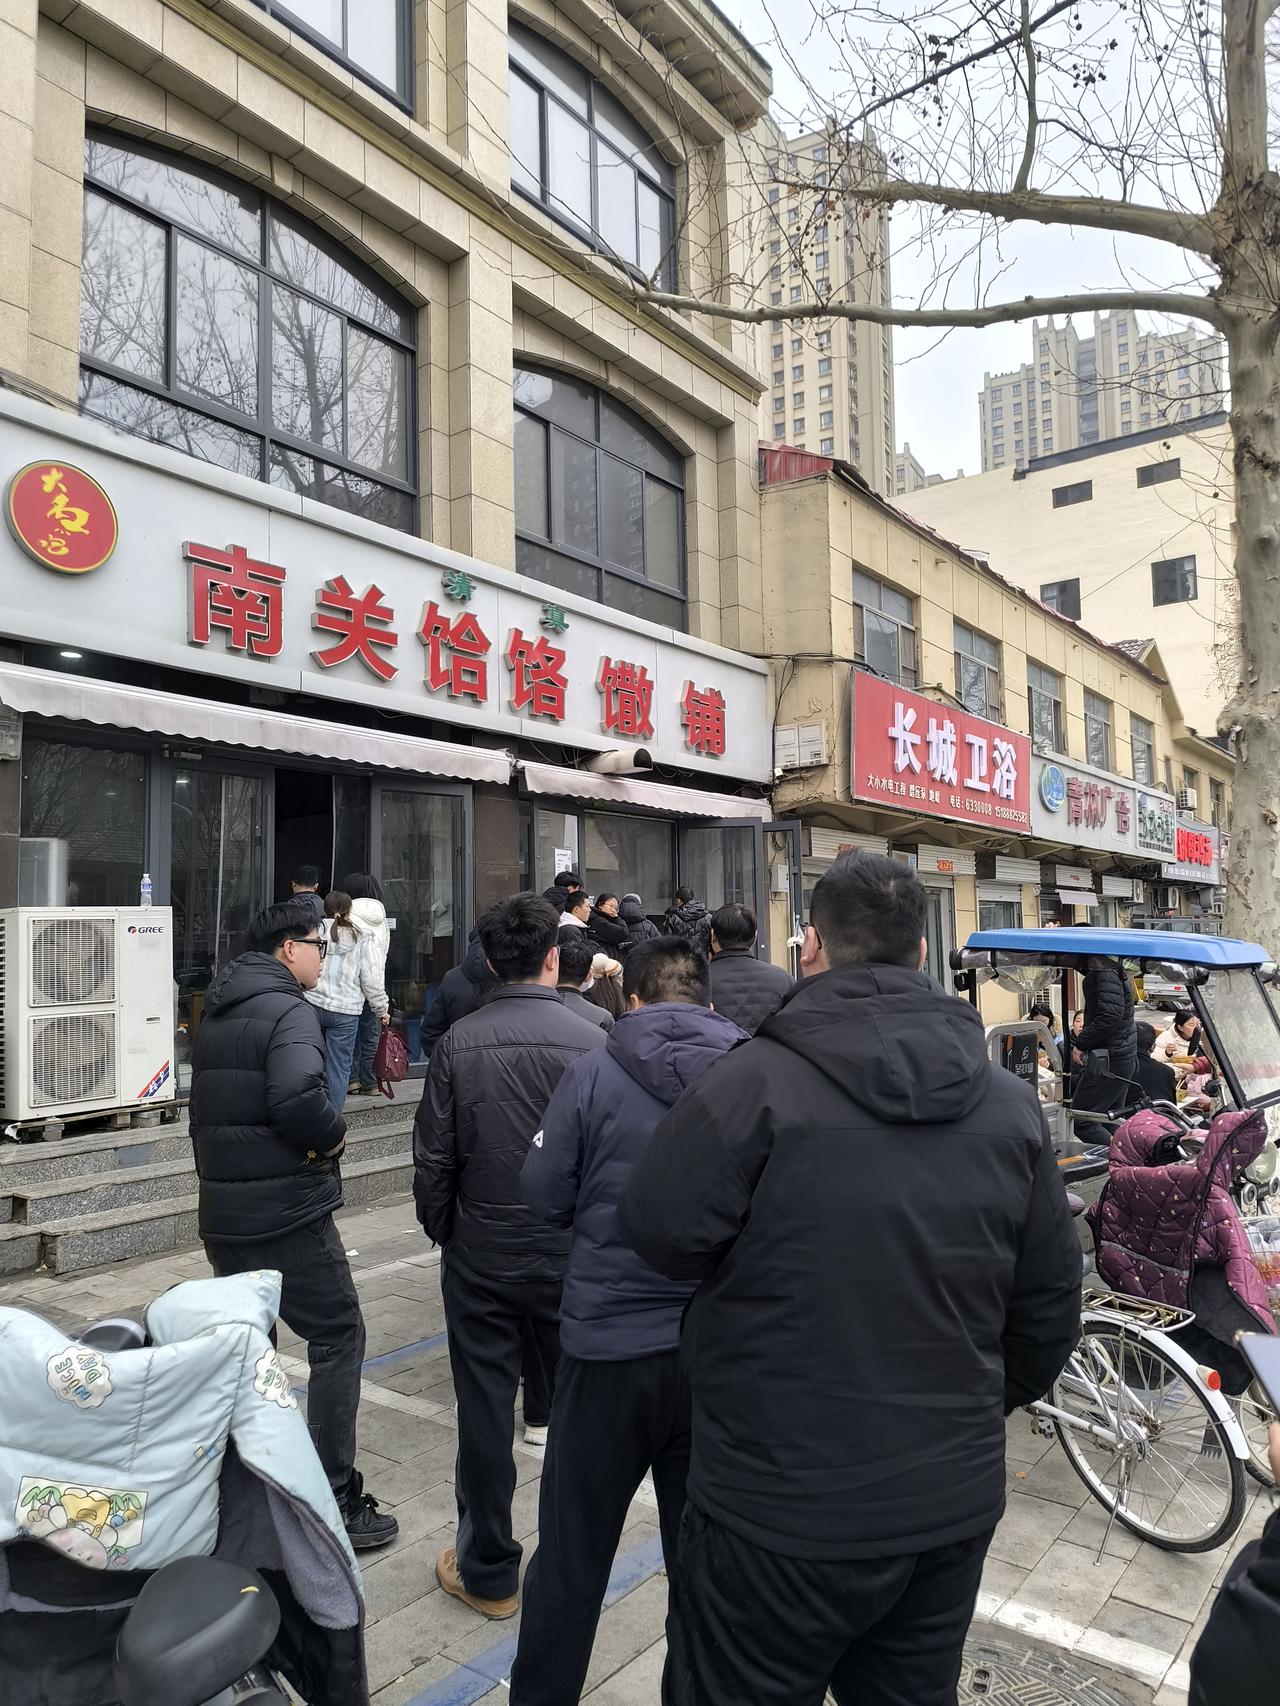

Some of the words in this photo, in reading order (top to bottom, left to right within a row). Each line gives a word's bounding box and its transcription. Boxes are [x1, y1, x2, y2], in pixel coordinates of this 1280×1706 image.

[441, 570, 570, 634] 清真
[182, 540, 726, 756] 南关饸饹馓铺
[888, 702, 1017, 800] 长城卫浴
[138, 926, 165, 934] GREE
[55, 1357, 93, 1402] NICE
[76, 1353, 102, 1385] DAY
